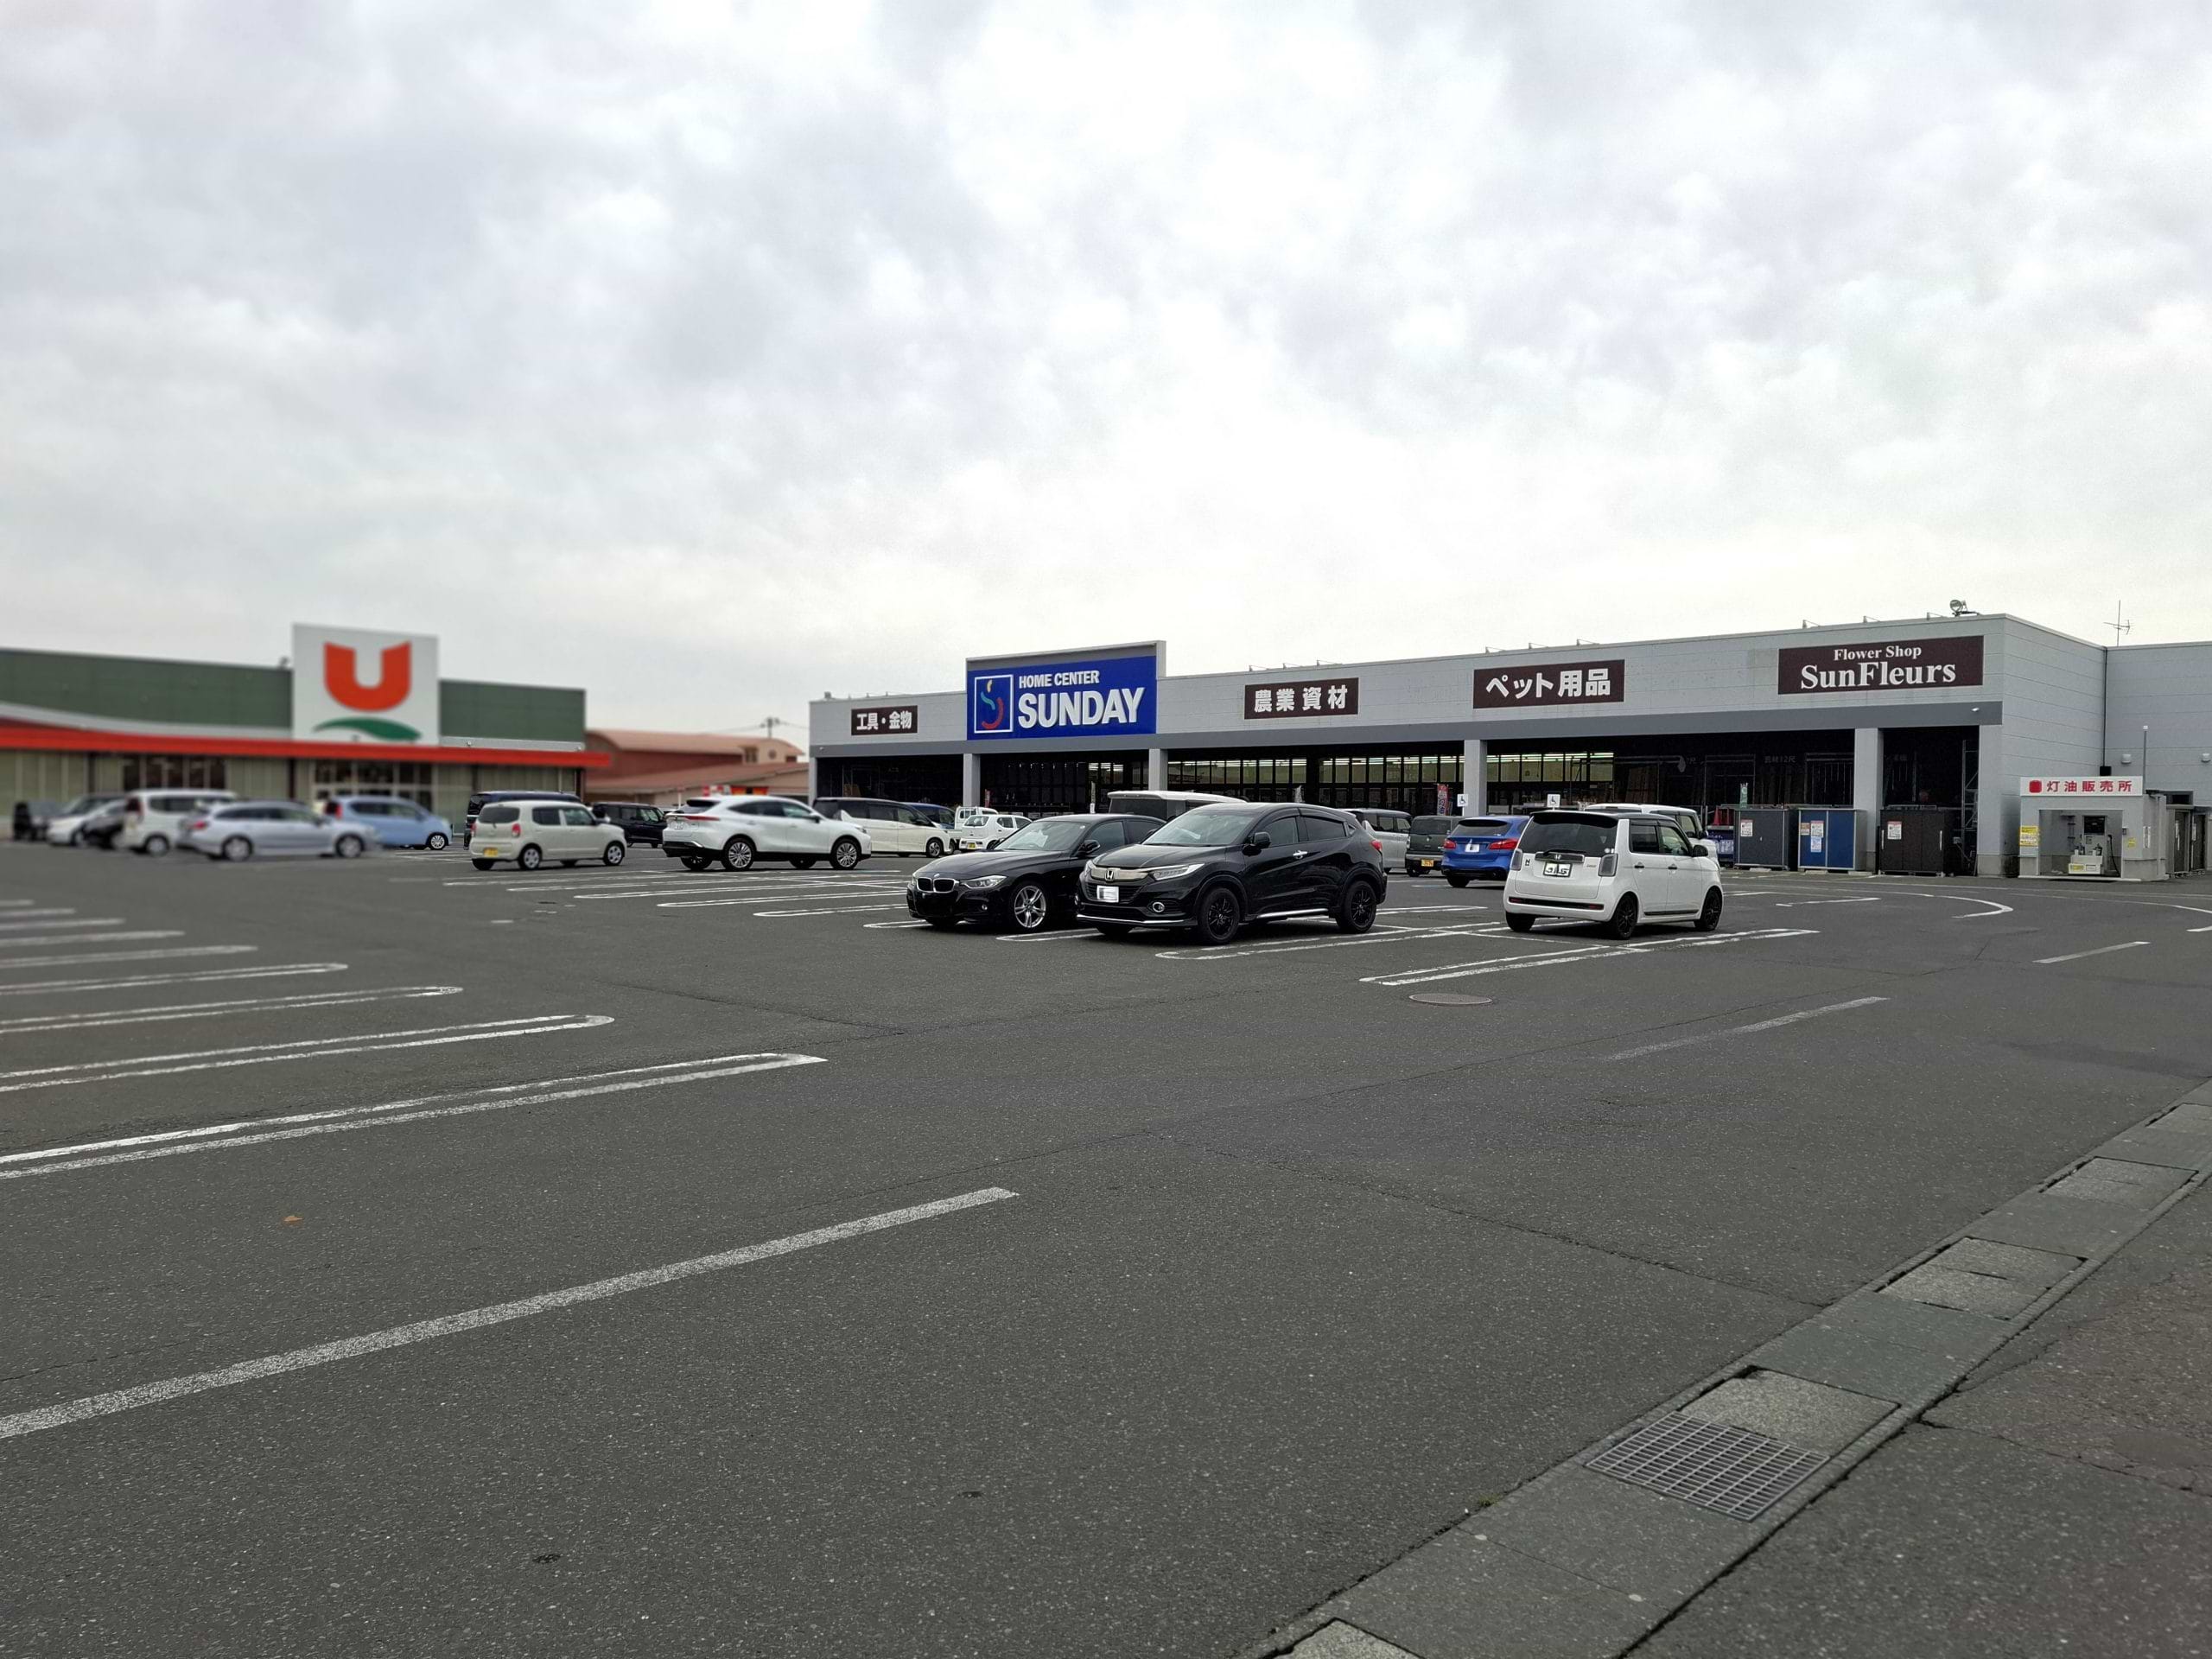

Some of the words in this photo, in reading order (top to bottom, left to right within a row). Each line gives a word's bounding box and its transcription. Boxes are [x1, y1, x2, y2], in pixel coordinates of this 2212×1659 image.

[1833, 648, 1883, 661] Flower
[1885, 645, 1923, 659] Shop
[1019, 674, 1052, 690] HOME
[1053, 670, 1100, 687] CENTER
[1485, 668, 1611, 699] ペット用品
[1801, 661, 1956, 690] SunFleurs
[1018, 687, 1145, 728] SUNDAY
[1254, 684, 1348, 713] 農業資材
[856, 710, 912, 730] 工具・金物
[2046, 780, 2133, 792] 灯油販売所
